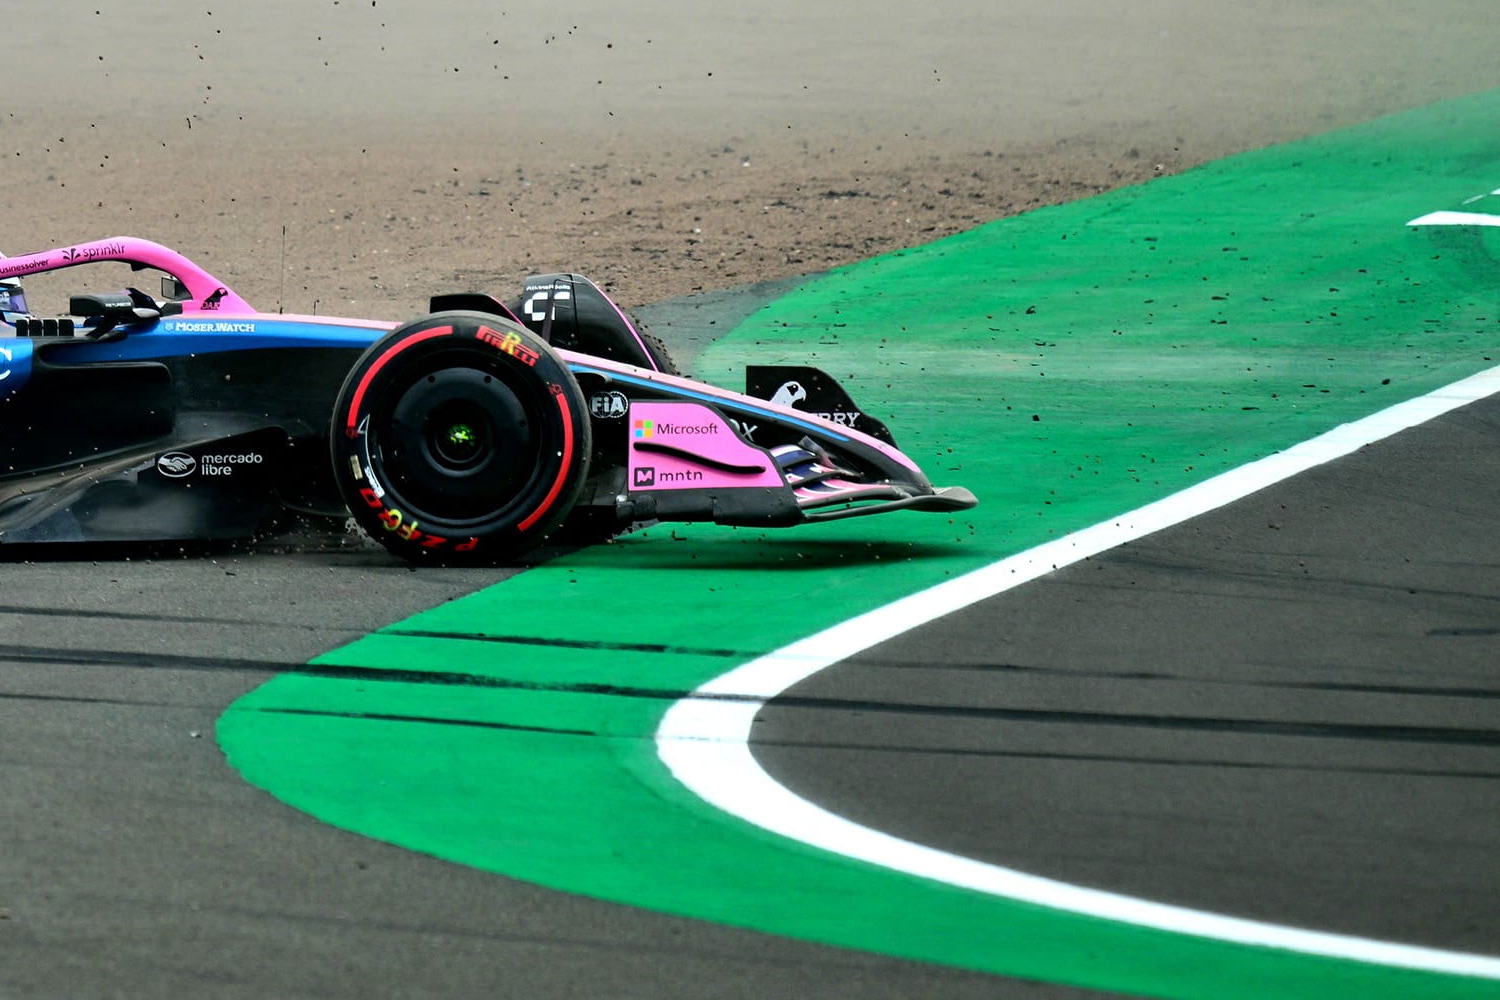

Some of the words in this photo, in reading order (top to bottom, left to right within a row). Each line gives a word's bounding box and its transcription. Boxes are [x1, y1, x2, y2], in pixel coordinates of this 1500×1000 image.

[83, 243, 126, 260] sprinklr
[475, 325, 541, 367] PIRELLI
[657, 423, 718, 435] Microsoft
[202, 452, 263, 463] mercado
[201, 464, 232, 475] libre
[660, 470, 703, 481] mntn
